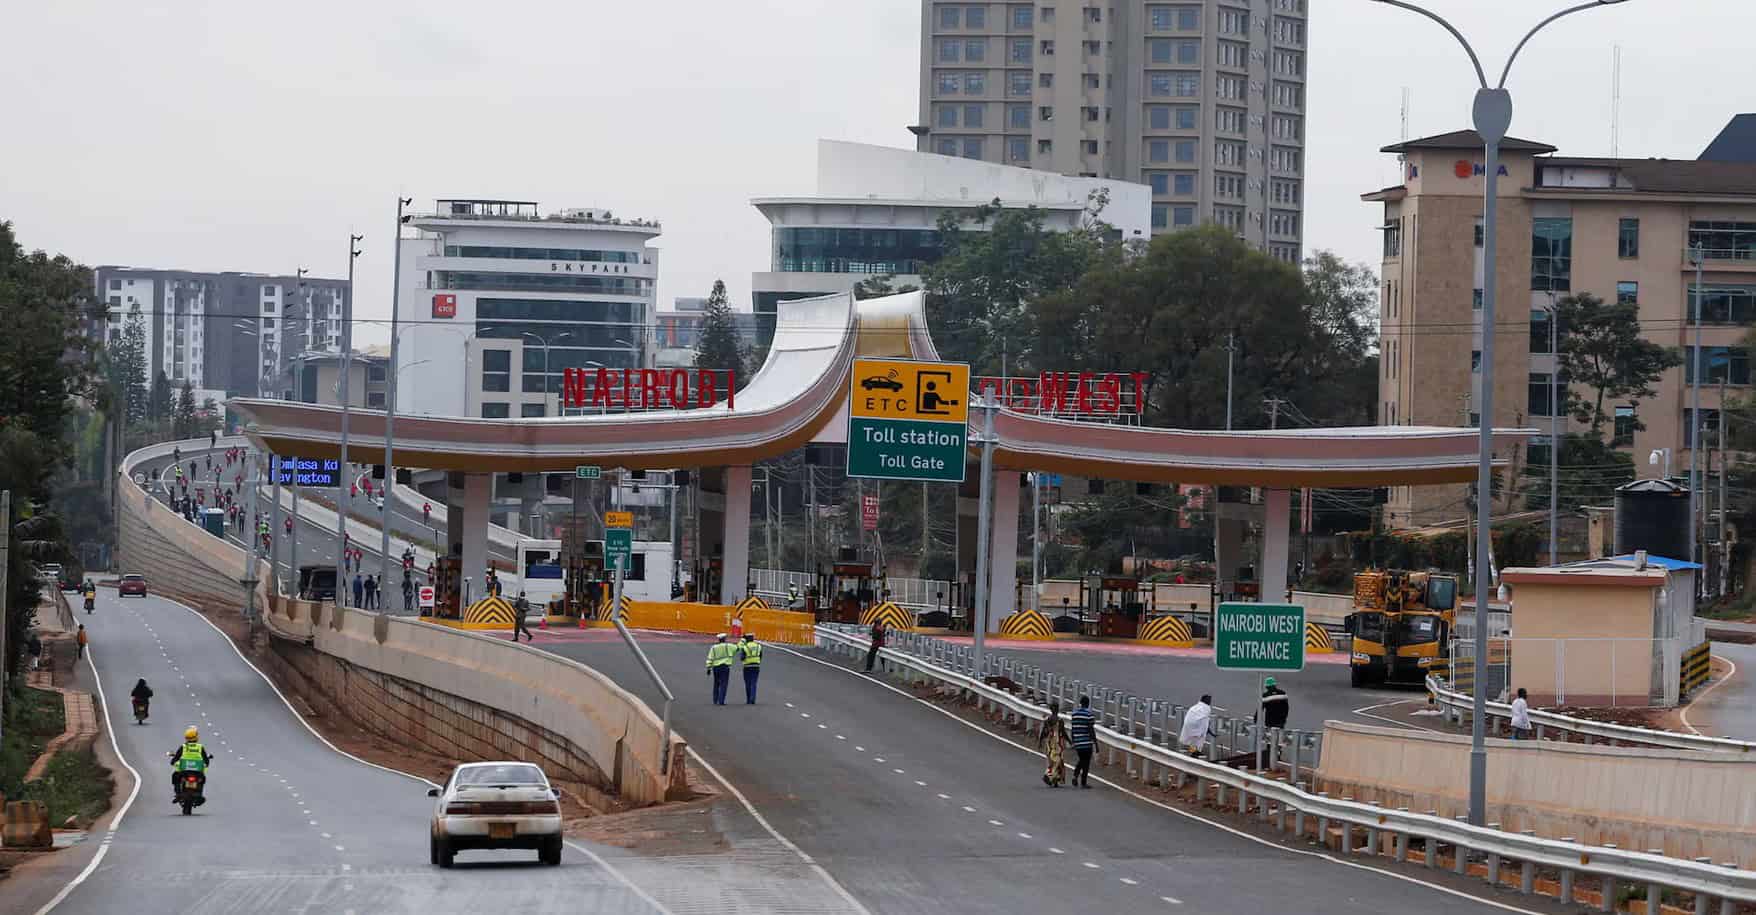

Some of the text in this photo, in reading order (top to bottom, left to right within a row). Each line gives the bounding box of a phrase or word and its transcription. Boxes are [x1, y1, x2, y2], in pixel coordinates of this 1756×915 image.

[551, 263, 628, 273] SKYPARK
[564, 368, 735, 409] NAIROBI
[1040, 370, 1150, 416] WEST
[866, 398, 907, 411] ETC
[863, 427, 960, 446] Toll station
[271, 456, 318, 470] omasa
[879, 454, 945, 470] Toll Gate
[271, 470, 331, 484] avngton
[1220, 613, 1301, 634] NAIROBI WEST
[1229, 640, 1290, 660] ENTRANCE
